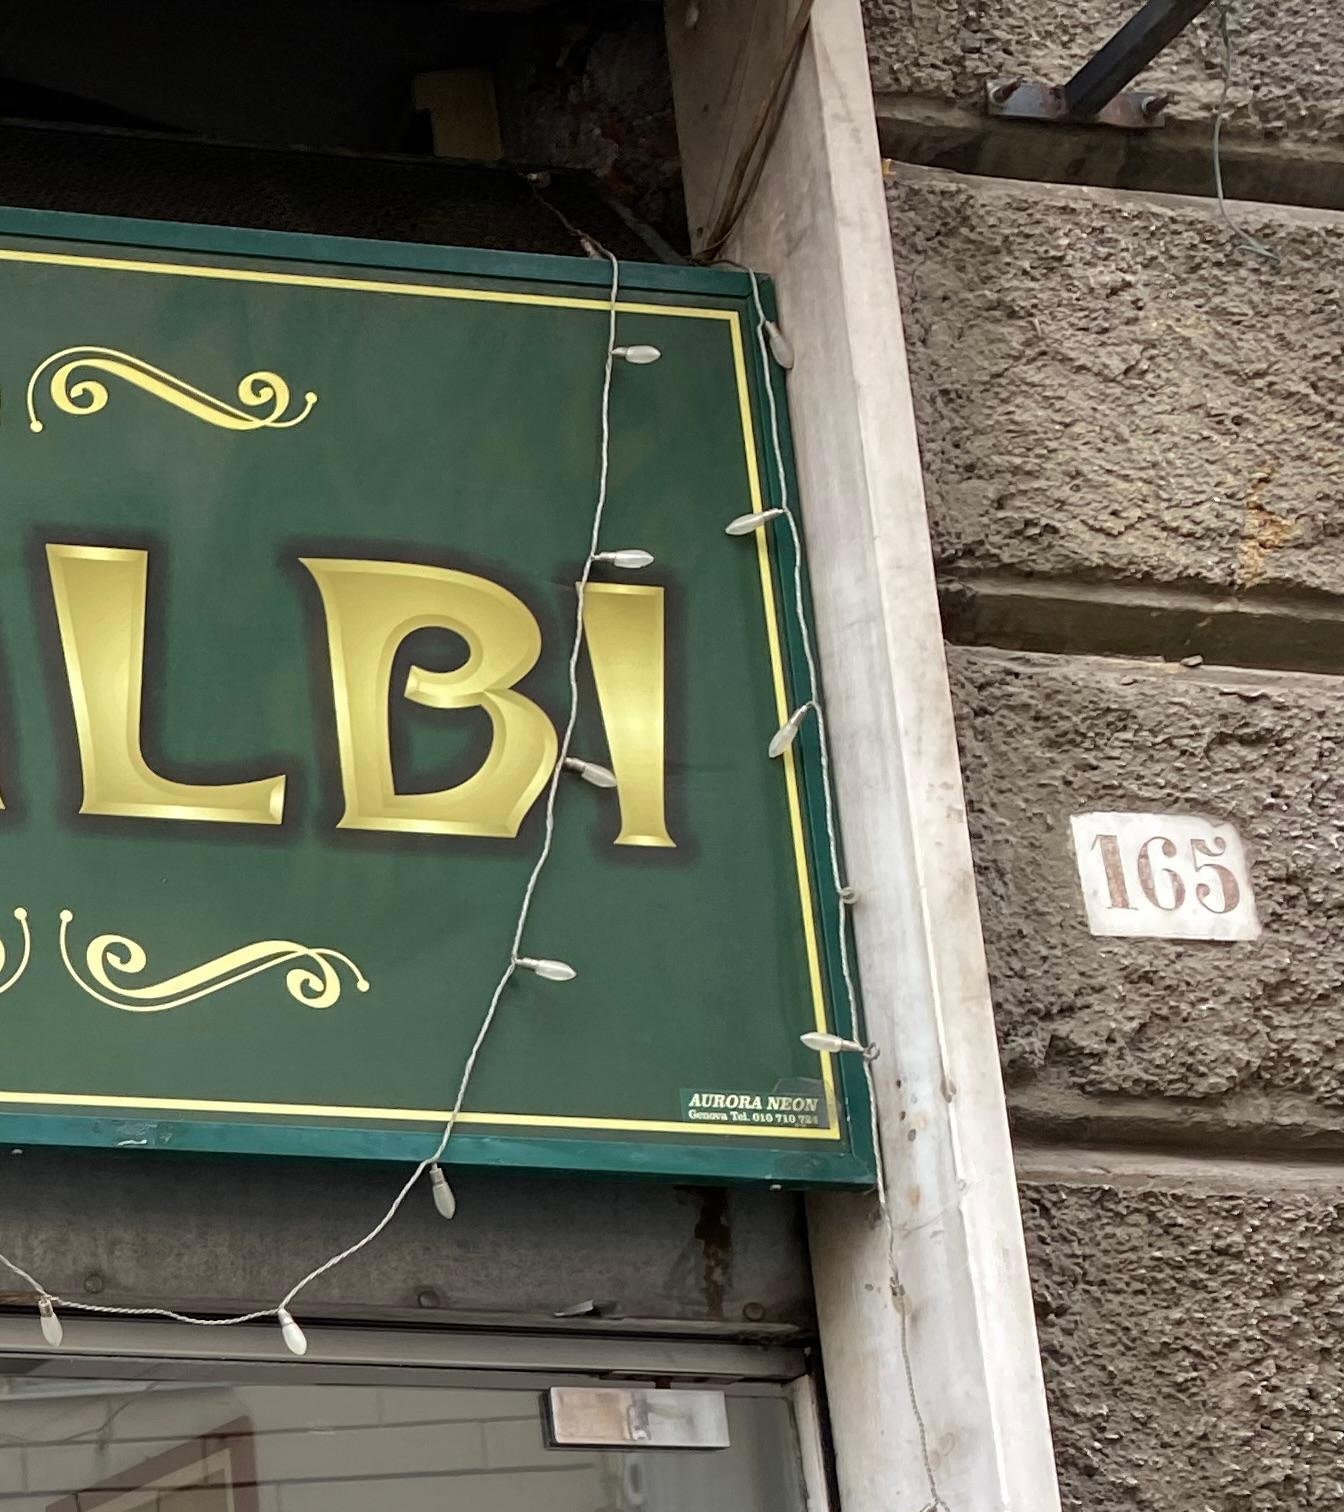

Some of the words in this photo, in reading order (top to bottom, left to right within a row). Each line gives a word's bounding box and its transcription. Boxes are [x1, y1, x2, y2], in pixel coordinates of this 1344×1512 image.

[1091, 835, 1239, 914] 165
[689, 1093, 762, 1110] AURORA
[767, 1097, 819, 1112] NEON
[688, 1109, 728, 1121] Genova
[730, 1111, 751, 1121] Tel.
